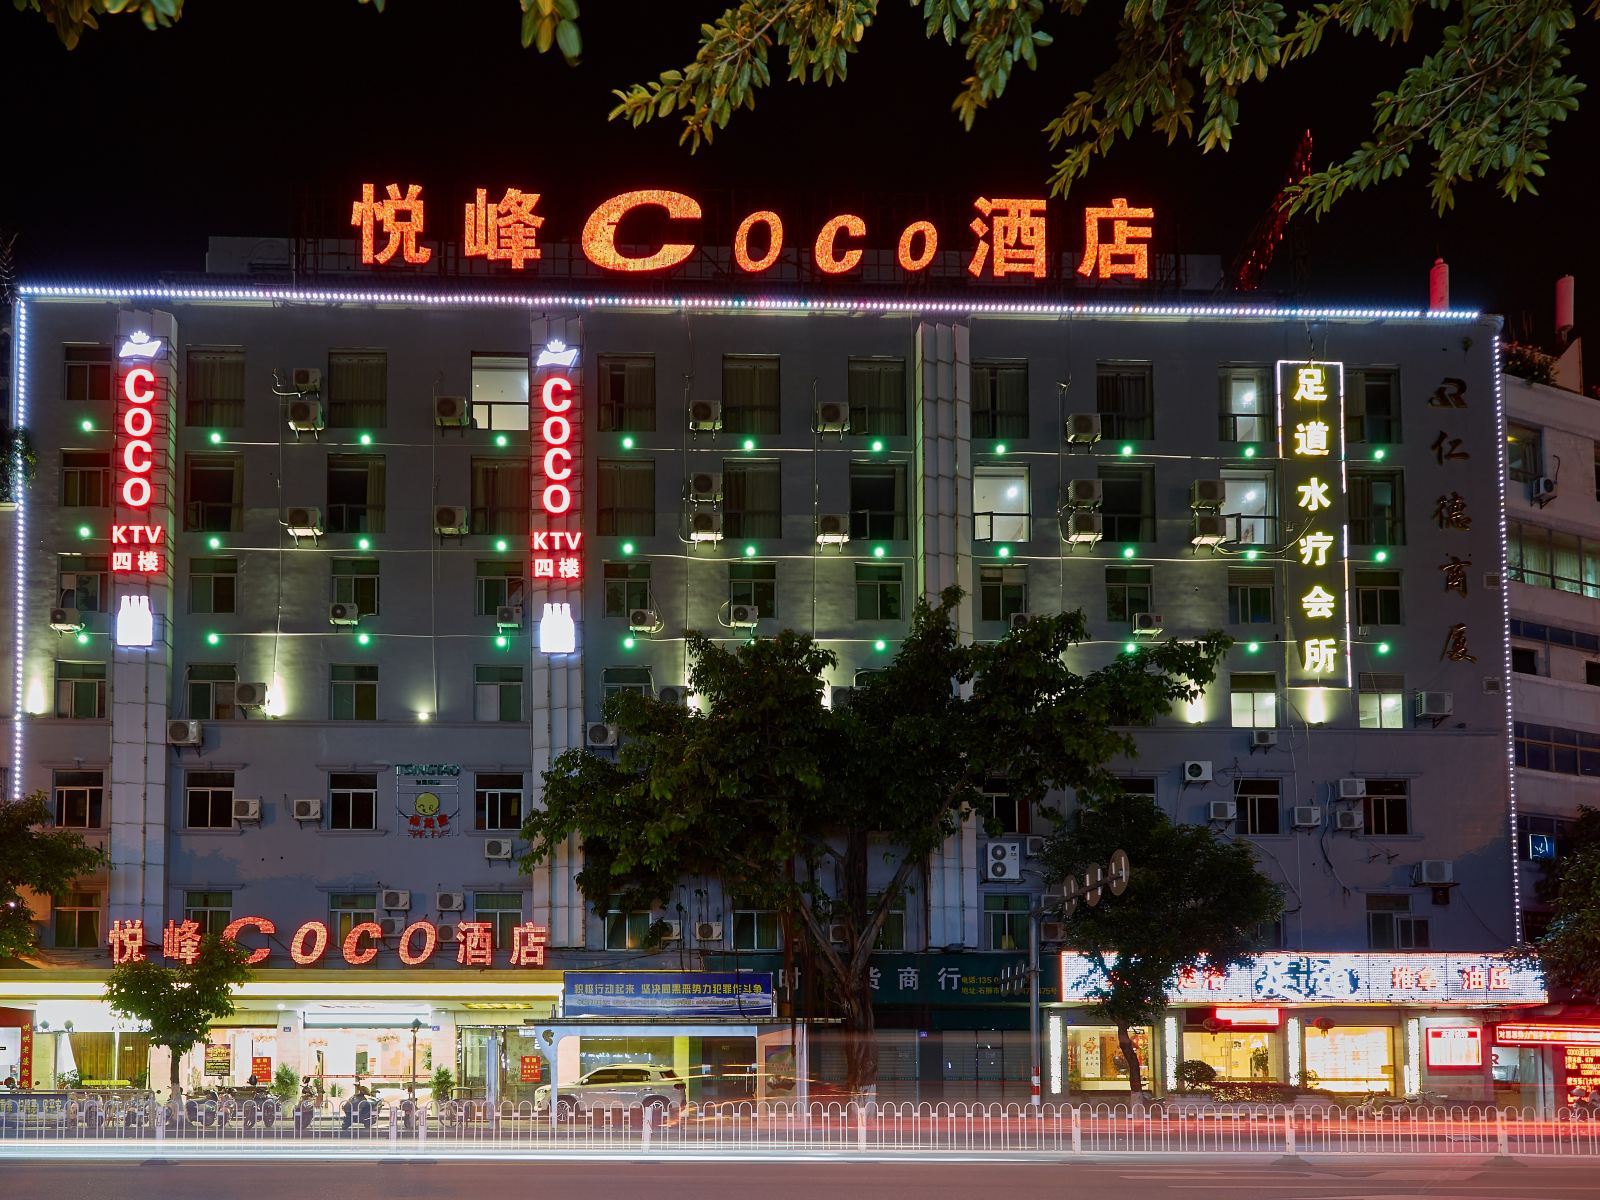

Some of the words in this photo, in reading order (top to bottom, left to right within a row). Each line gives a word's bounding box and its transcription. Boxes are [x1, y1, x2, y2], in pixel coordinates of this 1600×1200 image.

[123, 368, 155, 507] COCO
[541, 377, 572, 513] COCO
[1294, 368, 1337, 673] 足道水疗会所
[112, 525, 162, 544] KTV
[533, 531, 582, 550] KTV
[112, 551, 160, 573] 四楼
[534, 557, 580, 579] 四楼
